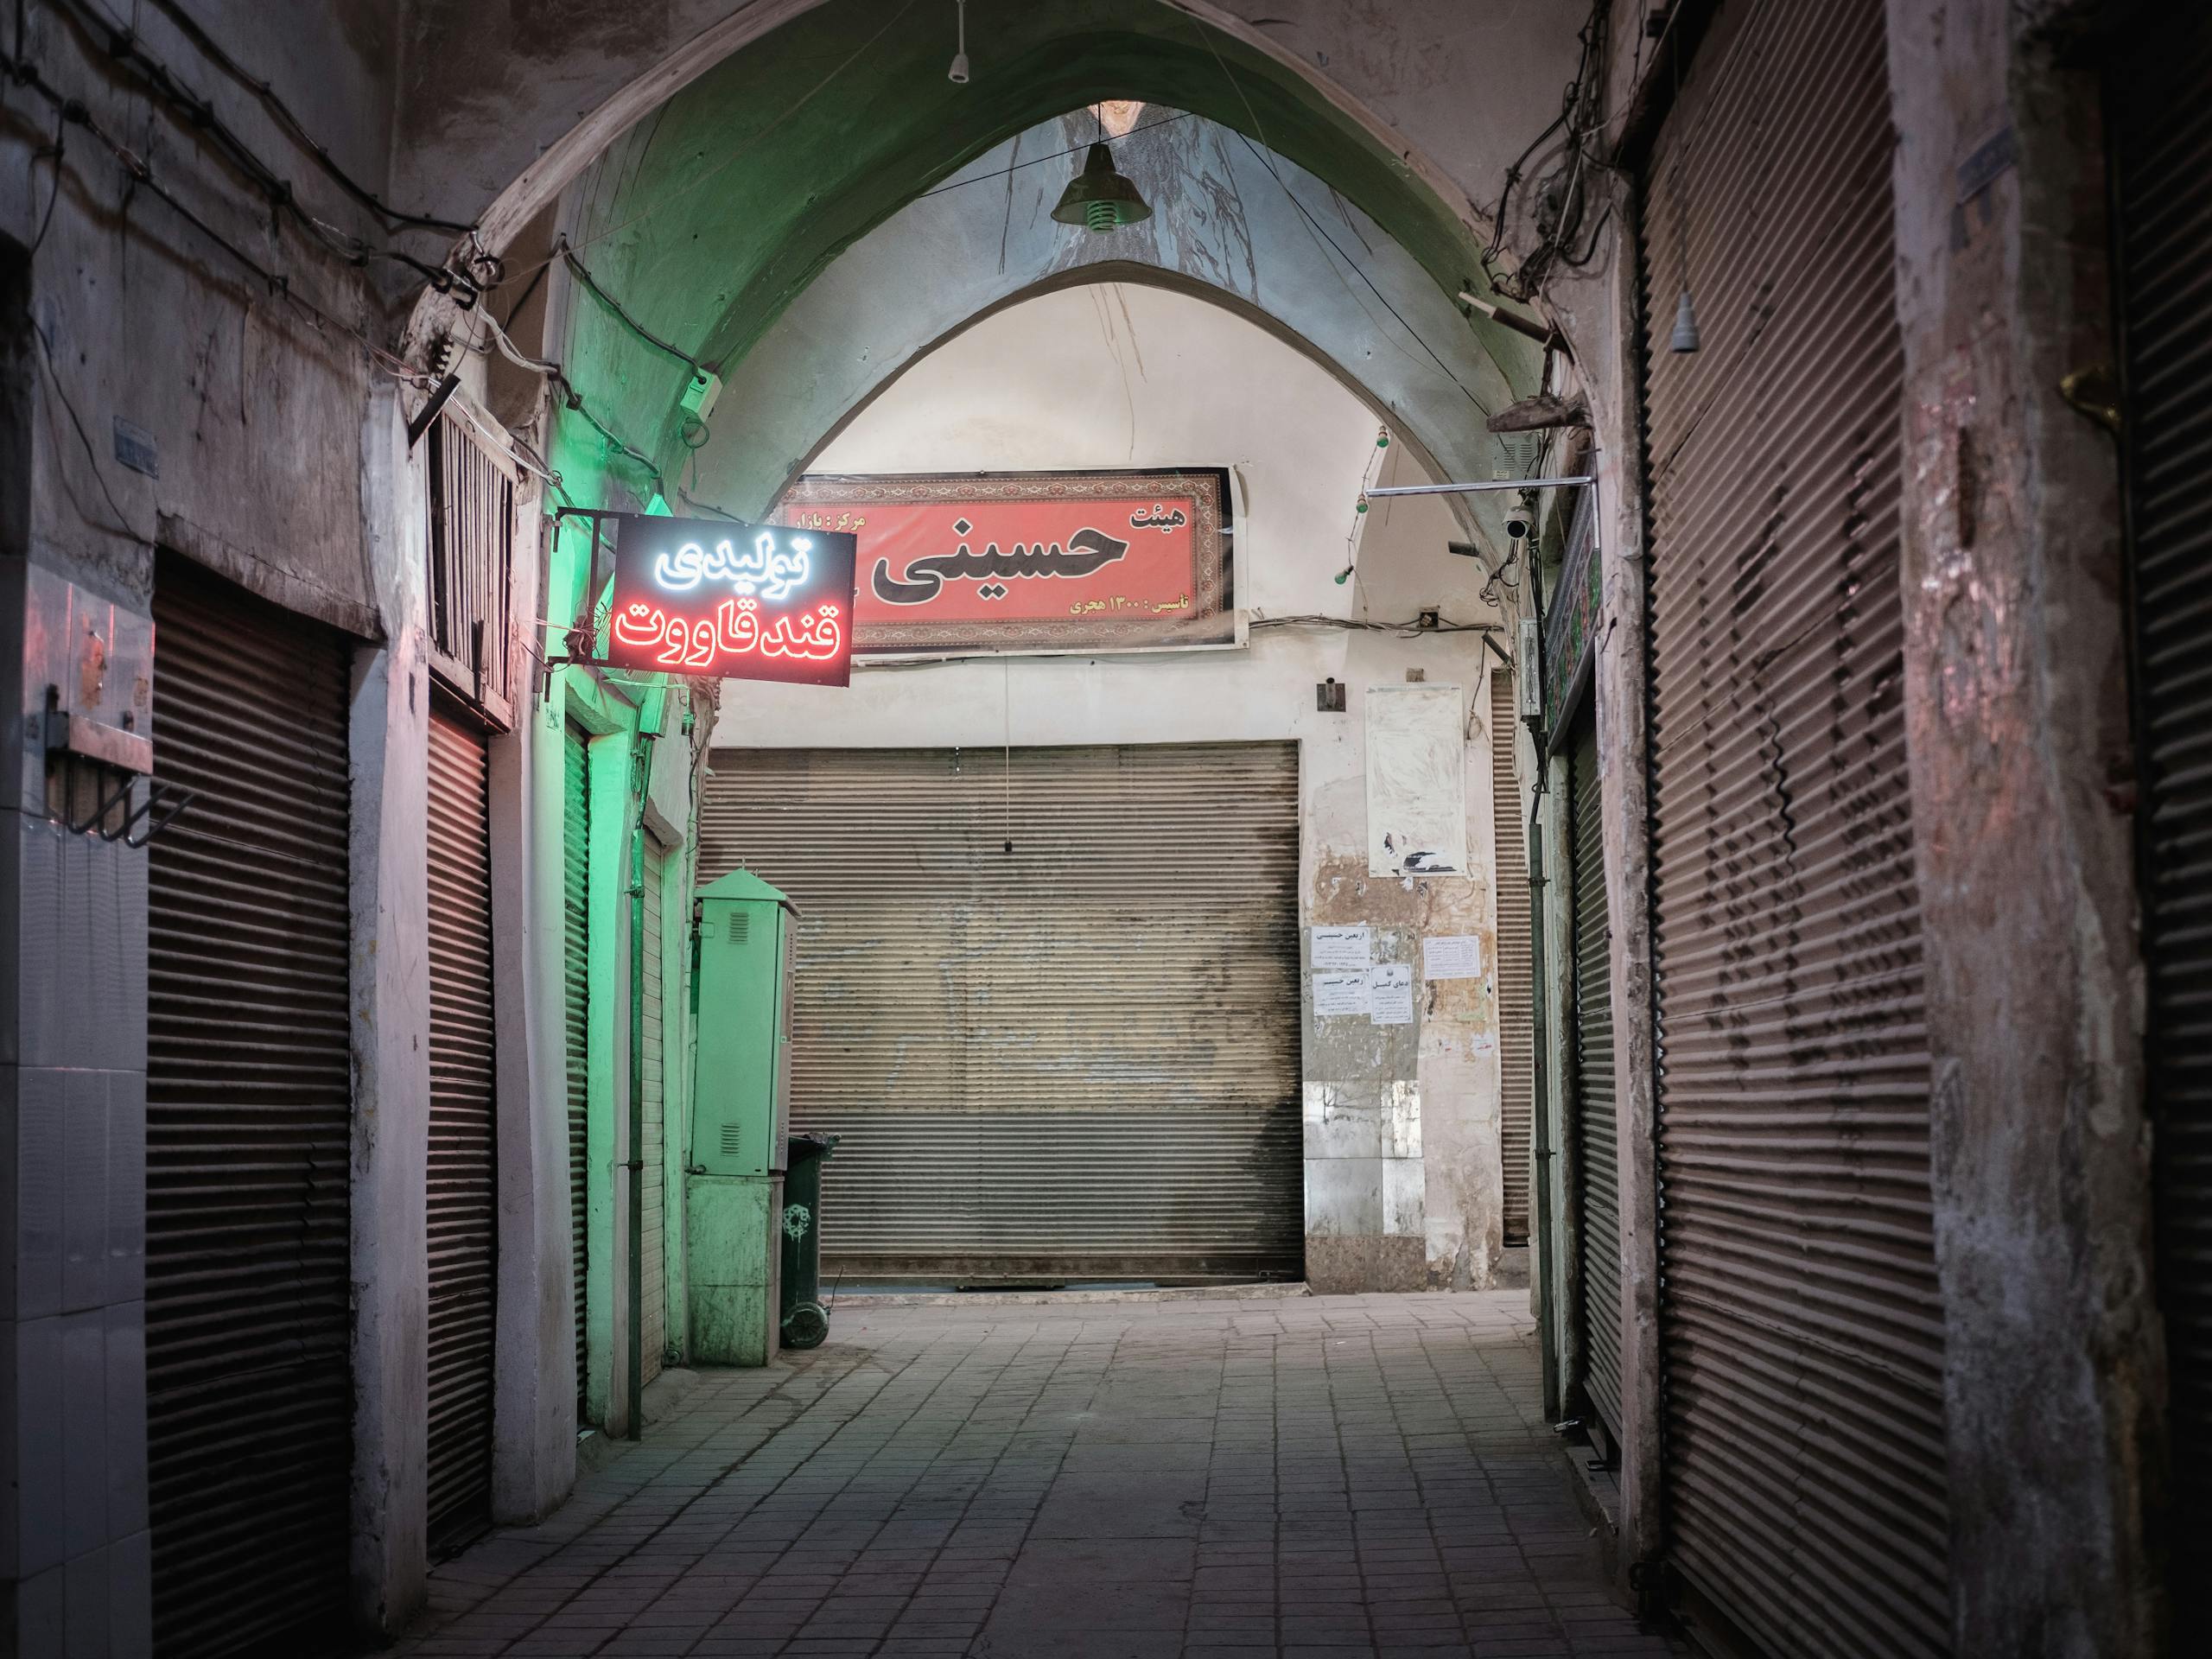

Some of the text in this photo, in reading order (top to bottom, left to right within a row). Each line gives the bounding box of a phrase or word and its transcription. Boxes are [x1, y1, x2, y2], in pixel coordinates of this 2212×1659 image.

[834, 512, 866, 531] مرکز
[1129, 503, 1186, 533] هیئت
[654, 531, 813, 601] تولیدی
[873, 518, 1128, 605] حسینی
[1070, 600, 1106, 615] هجری
[614, 598, 841, 667] قند قاووت
